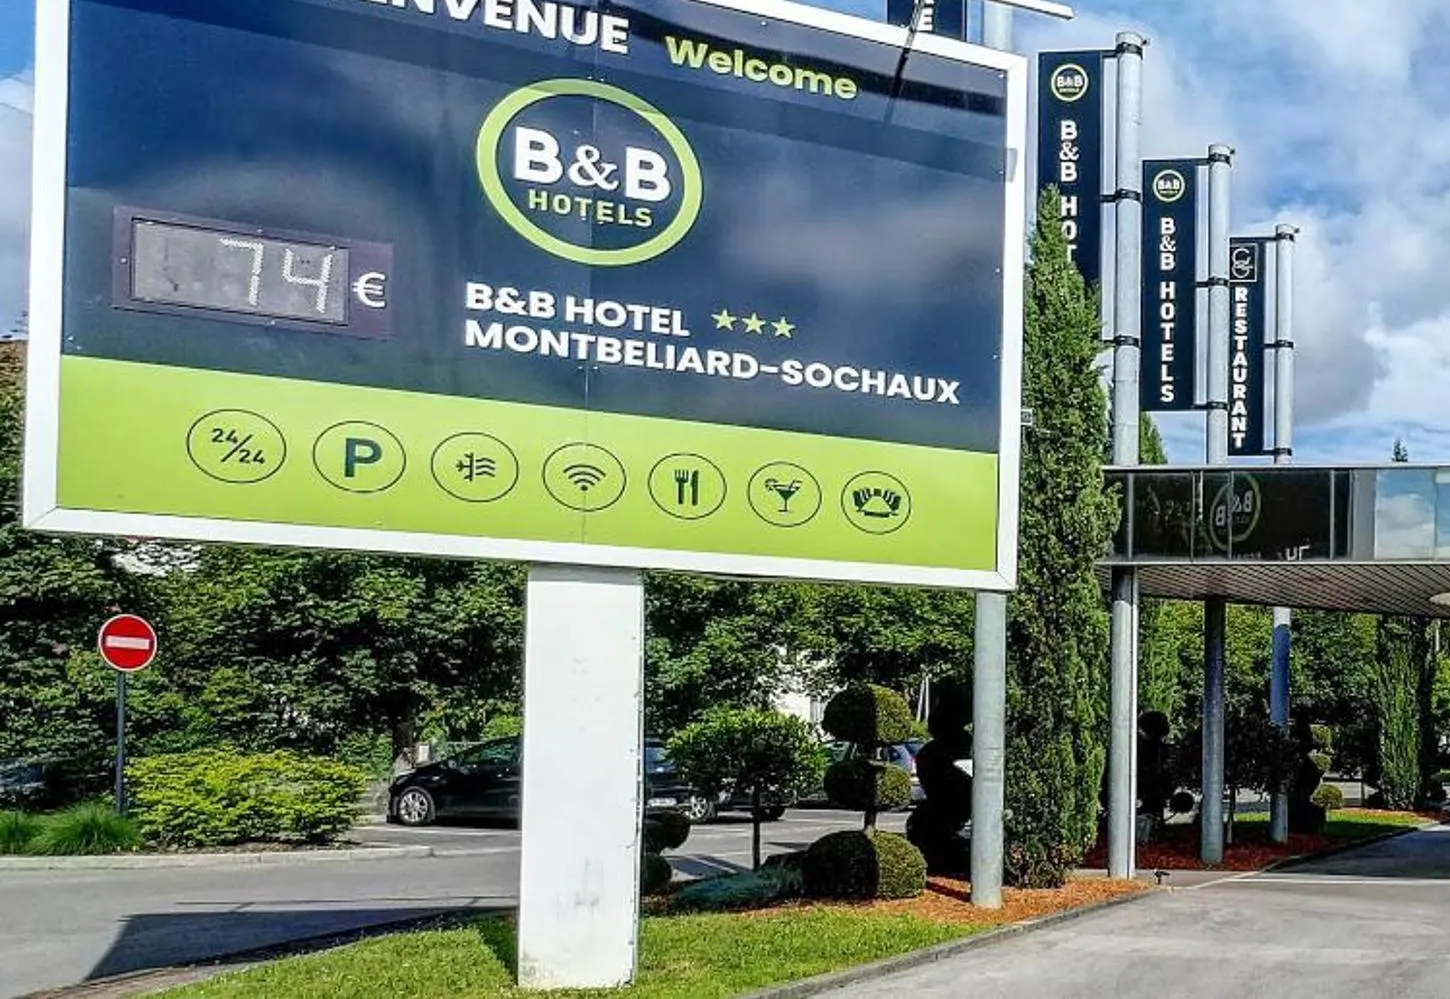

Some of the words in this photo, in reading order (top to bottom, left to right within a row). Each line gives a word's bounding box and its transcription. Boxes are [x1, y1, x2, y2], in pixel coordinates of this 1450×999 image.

[665, 36, 858, 99] Welcome
[514, 126, 672, 202] B&B
[1059, 120, 1079, 182] B&B
[528, 188, 653, 228] HOTELS
[1159, 217, 1176, 271] B&B
[465, 282, 557, 319] B&B
[565, 295, 691, 337] HOTEL
[465, 319, 960, 405] MONTBELIARD-SOCHAUX
[1159, 281, 1176, 403] HOTELS
[1231, 286, 1248, 449] RESTAURANT
[210, 427, 266, 465] 24/24
[343, 437, 382, 477] P
